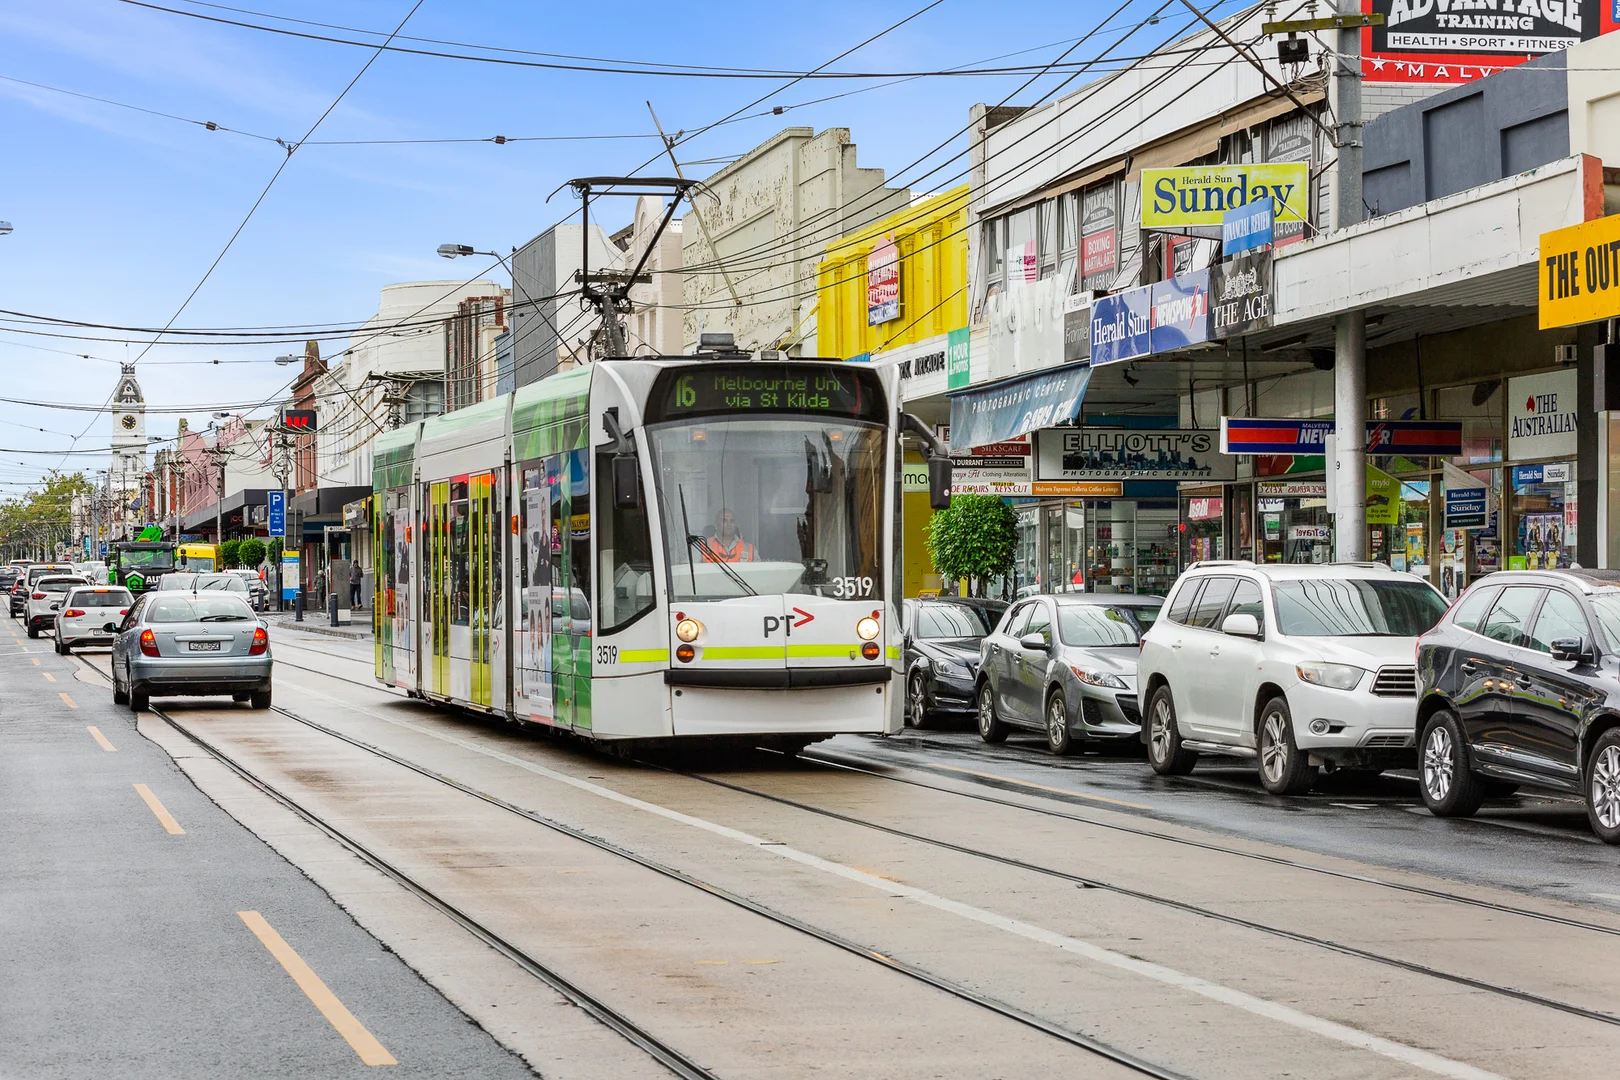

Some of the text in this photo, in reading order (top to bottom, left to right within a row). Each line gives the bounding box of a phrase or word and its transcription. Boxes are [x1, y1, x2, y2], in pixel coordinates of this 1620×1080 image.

[1436, 14, 1534, 30] TRAINING
[1392, 36, 1574, 49] HEALTH SPORT FITNESS
[1182, 175, 1233, 185] Herald Sun
[1154, 174, 1295, 218] Sunday
[1224, 209, 1271, 242] FINANCIAL REVIEW
[1088, 236, 1110, 256] BOXING
[1084, 255, 1103, 272] MARTIAL
[1546, 240, 1620, 301] THE OUT
[1213, 294, 1270, 329] THE AGE
[1093, 311, 1147, 346] Herald Sun
[953, 342, 968, 361] HOUR
[914, 351, 945, 377] ARCADE
[953, 359, 968, 375] PHOTOS
[676, 375, 841, 407] 16 Melbourne Uni
[725, 393, 830, 407] via St Kilda
[972, 388, 1031, 414] PHOTOGRAPHIC
[1035, 379, 1067, 398] CENTRE
[1536, 393, 1558, 415] THE
[1064, 433, 1212, 453] ELLIOTT'S
[1371, 479, 1390, 488] myki
[1519, 470, 1542, 480] Herald Sun
[1547, 469, 1566, 479] Sunday
[962, 485, 989, 493] REPAIRS
[994, 485, 1012, 493] KEYS
[1012, 485, 1029, 493] CUT
[272, 494, 282, 506] P
[1450, 504, 1481, 512] Sunday
[832, 576, 873, 597] 3519
[597, 645, 618, 665] 3519
